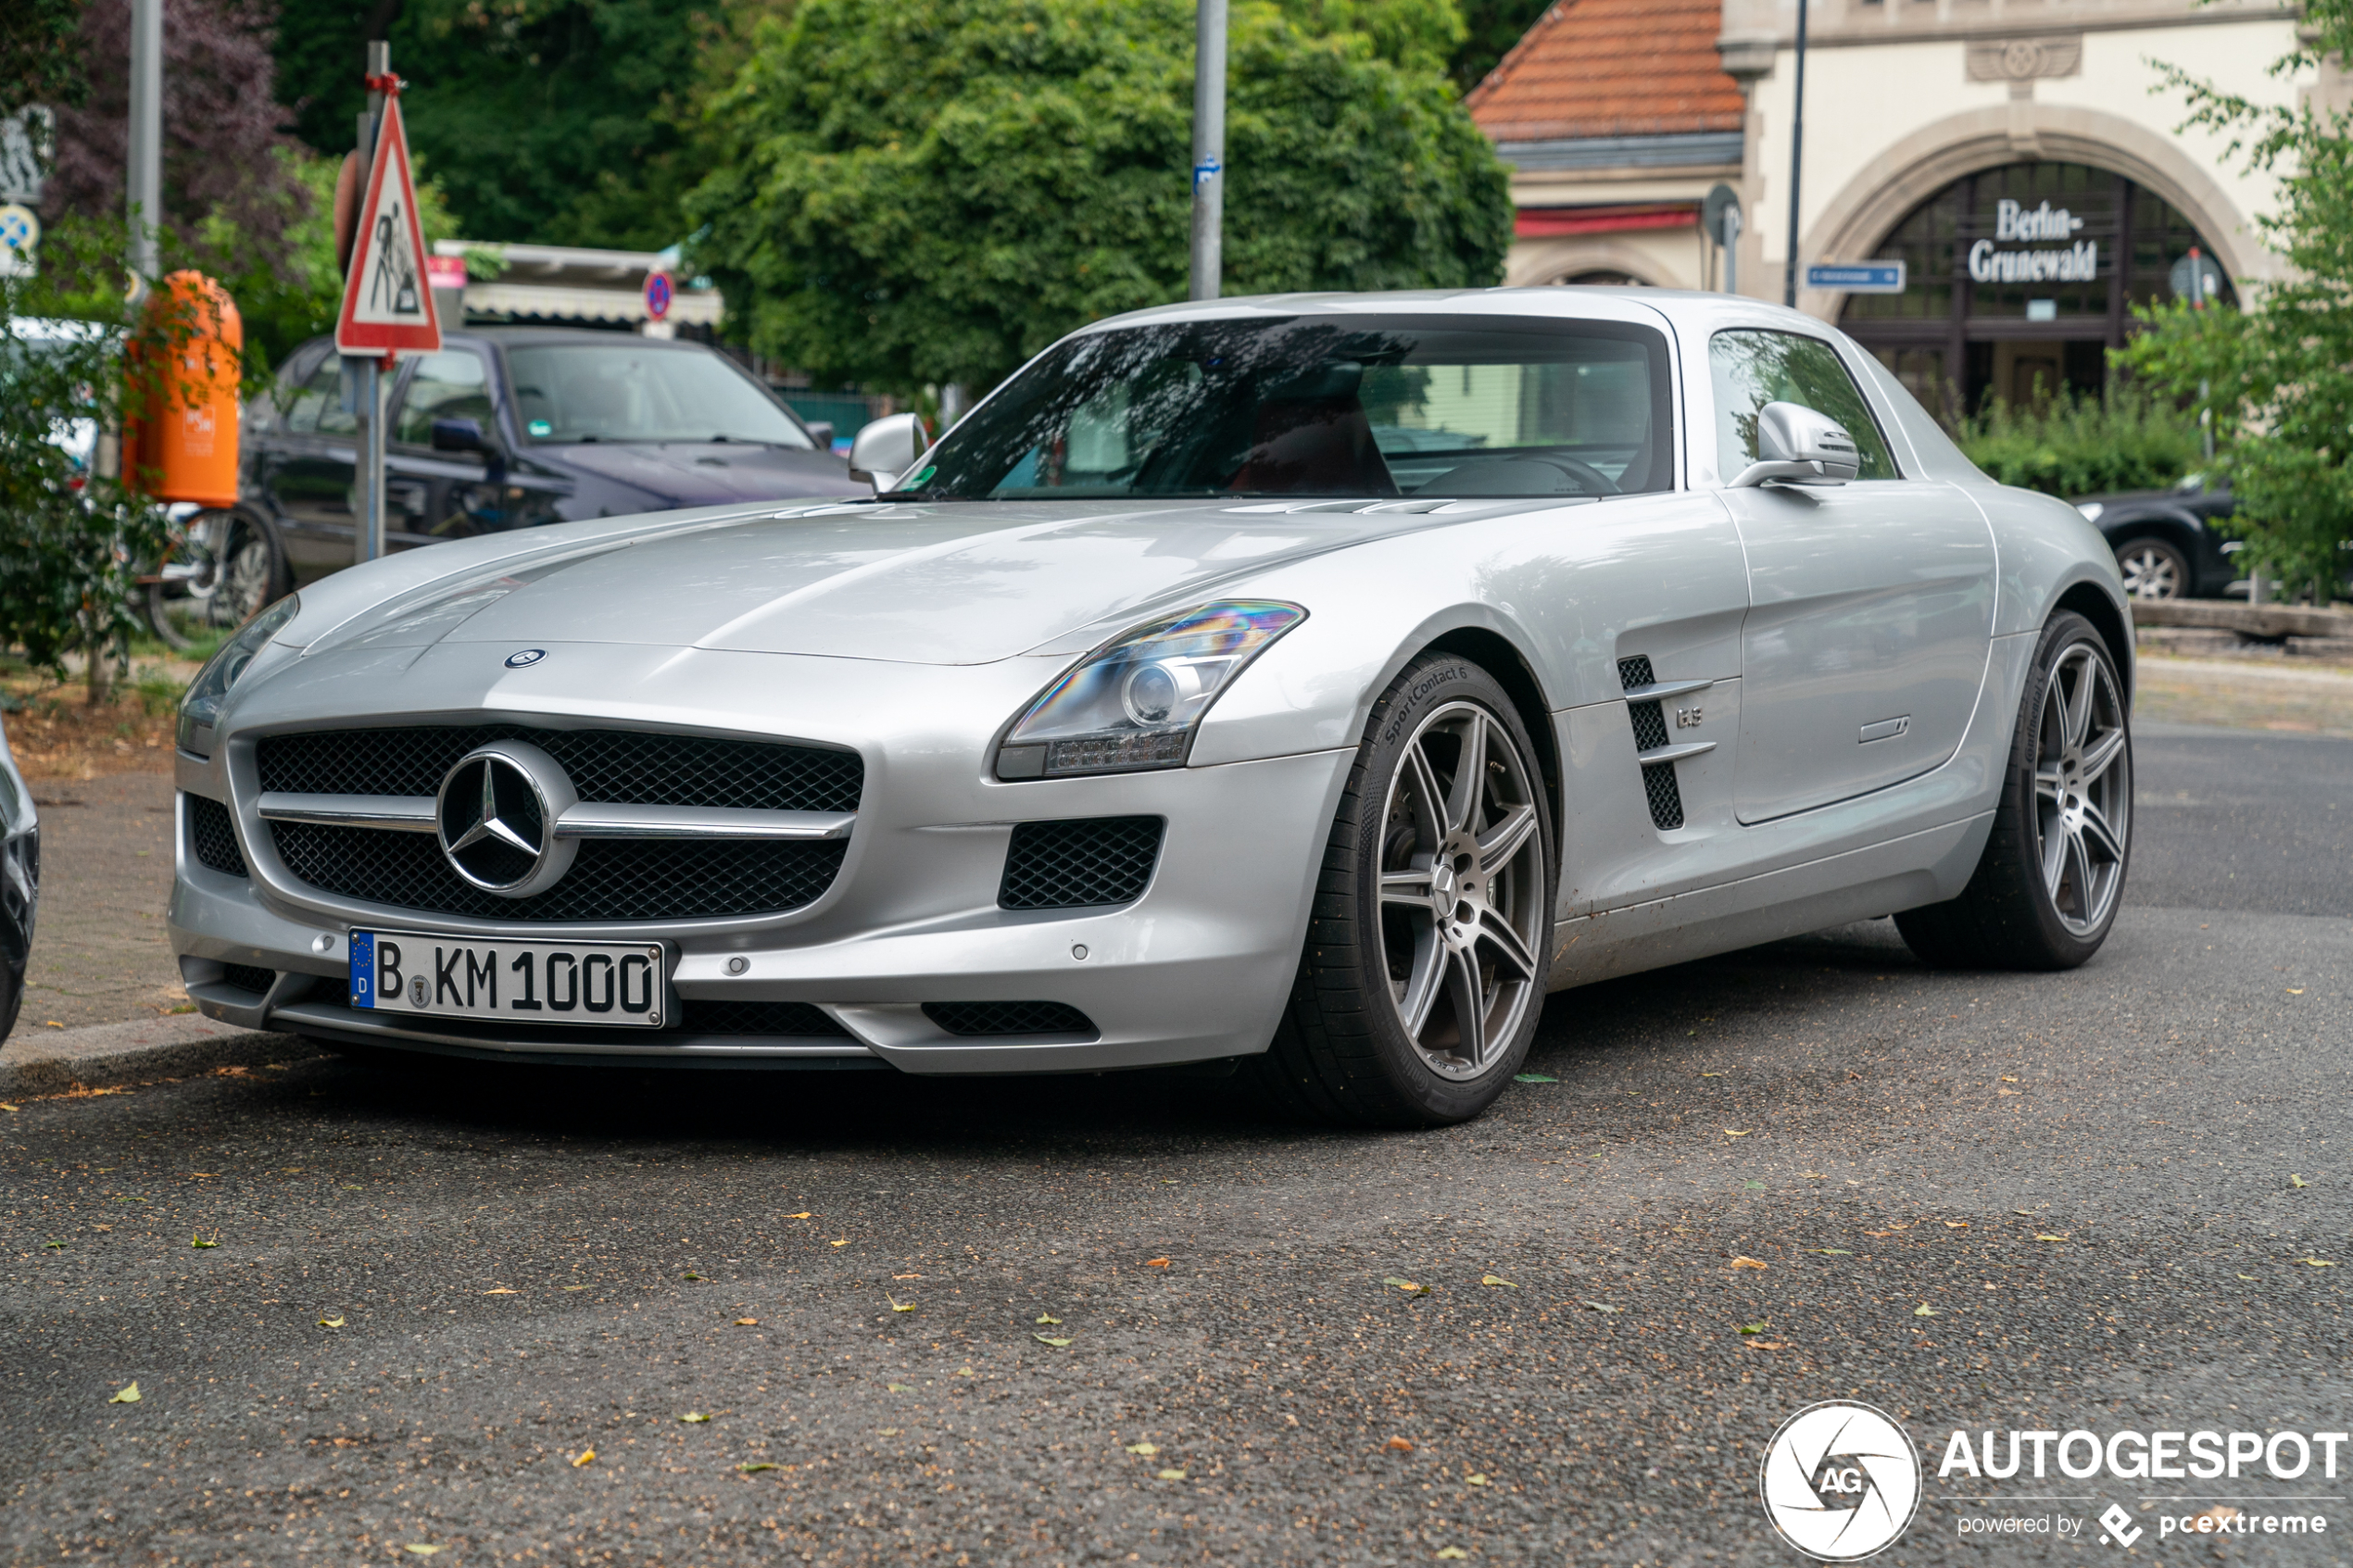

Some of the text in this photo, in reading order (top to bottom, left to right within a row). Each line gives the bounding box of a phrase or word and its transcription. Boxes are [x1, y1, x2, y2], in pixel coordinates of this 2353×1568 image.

[1968, 238, 2097, 283] Grunewald
[1385, 667, 1457, 746] SportContact
[358, 977, 368, 994] D
[377, 940, 652, 1013] B KM 1000
